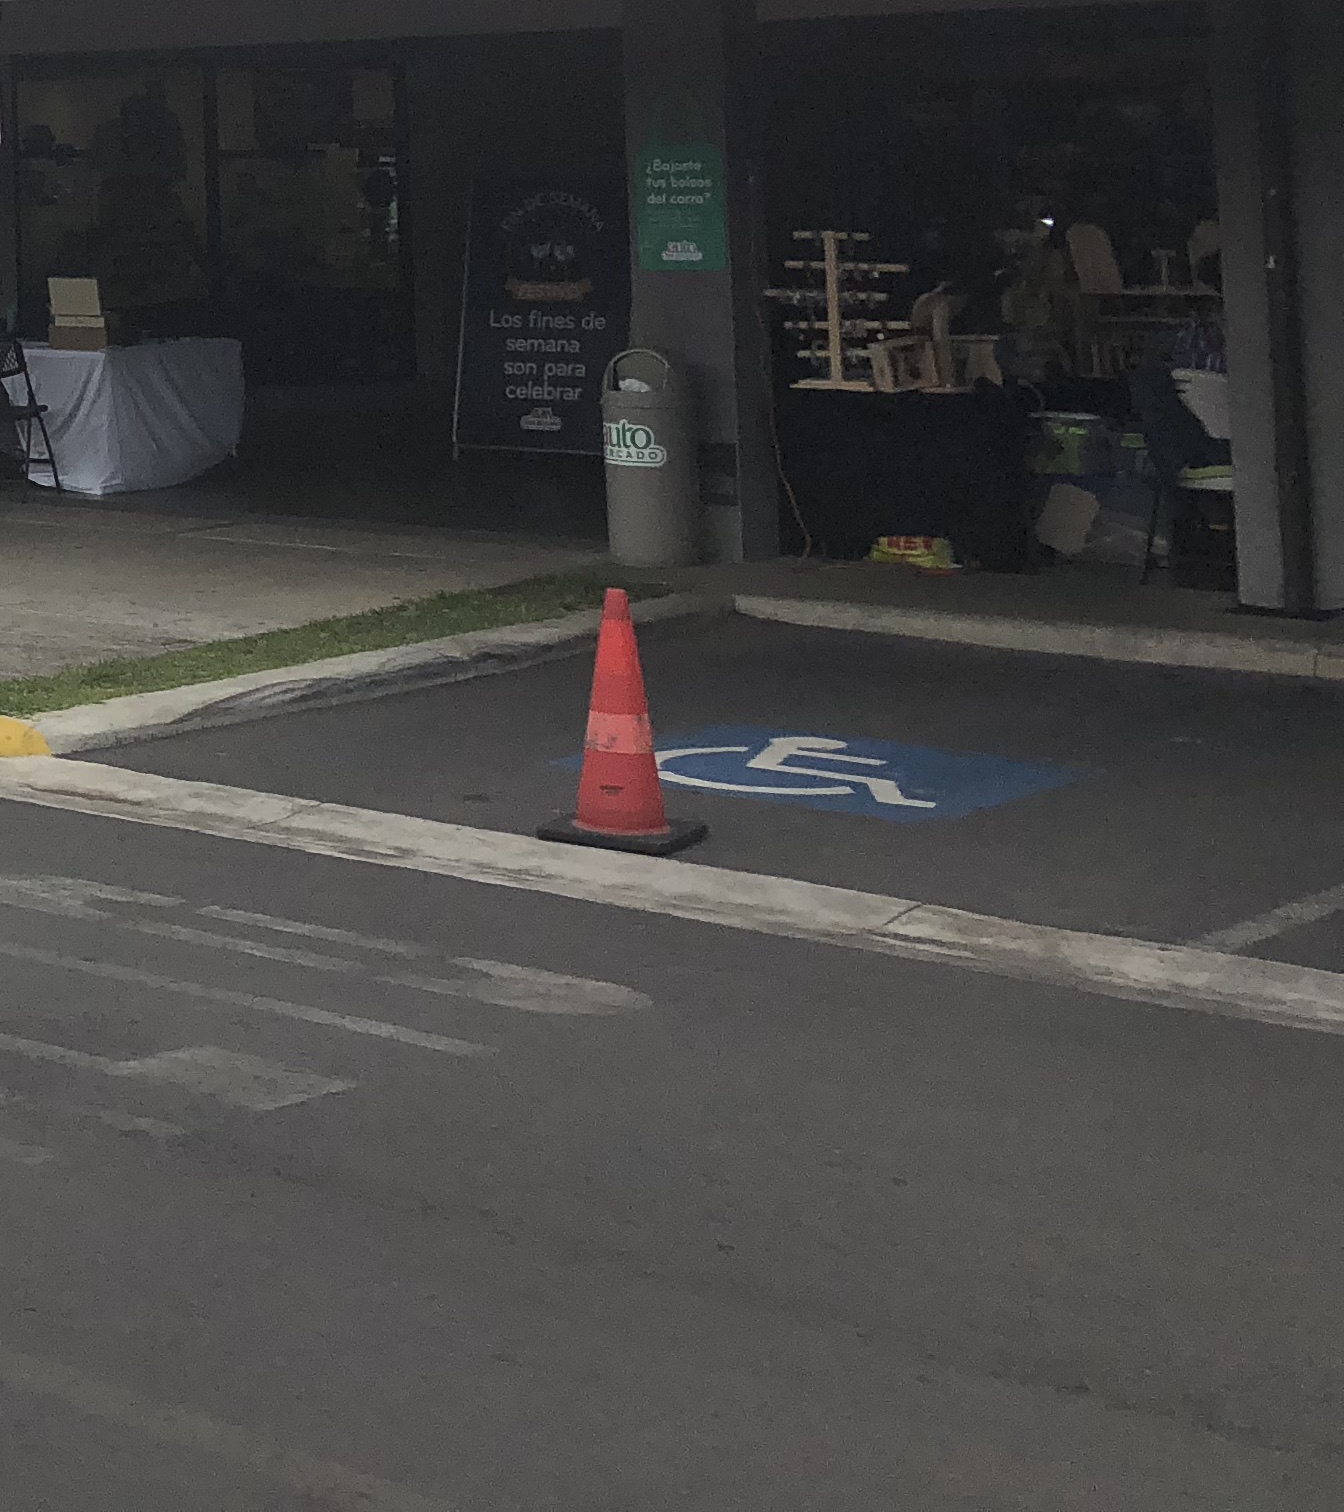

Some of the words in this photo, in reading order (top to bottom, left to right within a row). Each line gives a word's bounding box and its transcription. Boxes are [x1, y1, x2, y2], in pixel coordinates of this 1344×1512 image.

[490, 310, 522, 328] Los
[528, 310, 575, 329] fines
[581, 311, 606, 330] de
[506, 339, 580, 353] semana
[504, 362, 537, 375] son
[544, 363, 586, 382] para
[505, 381, 583, 400] celebrar
